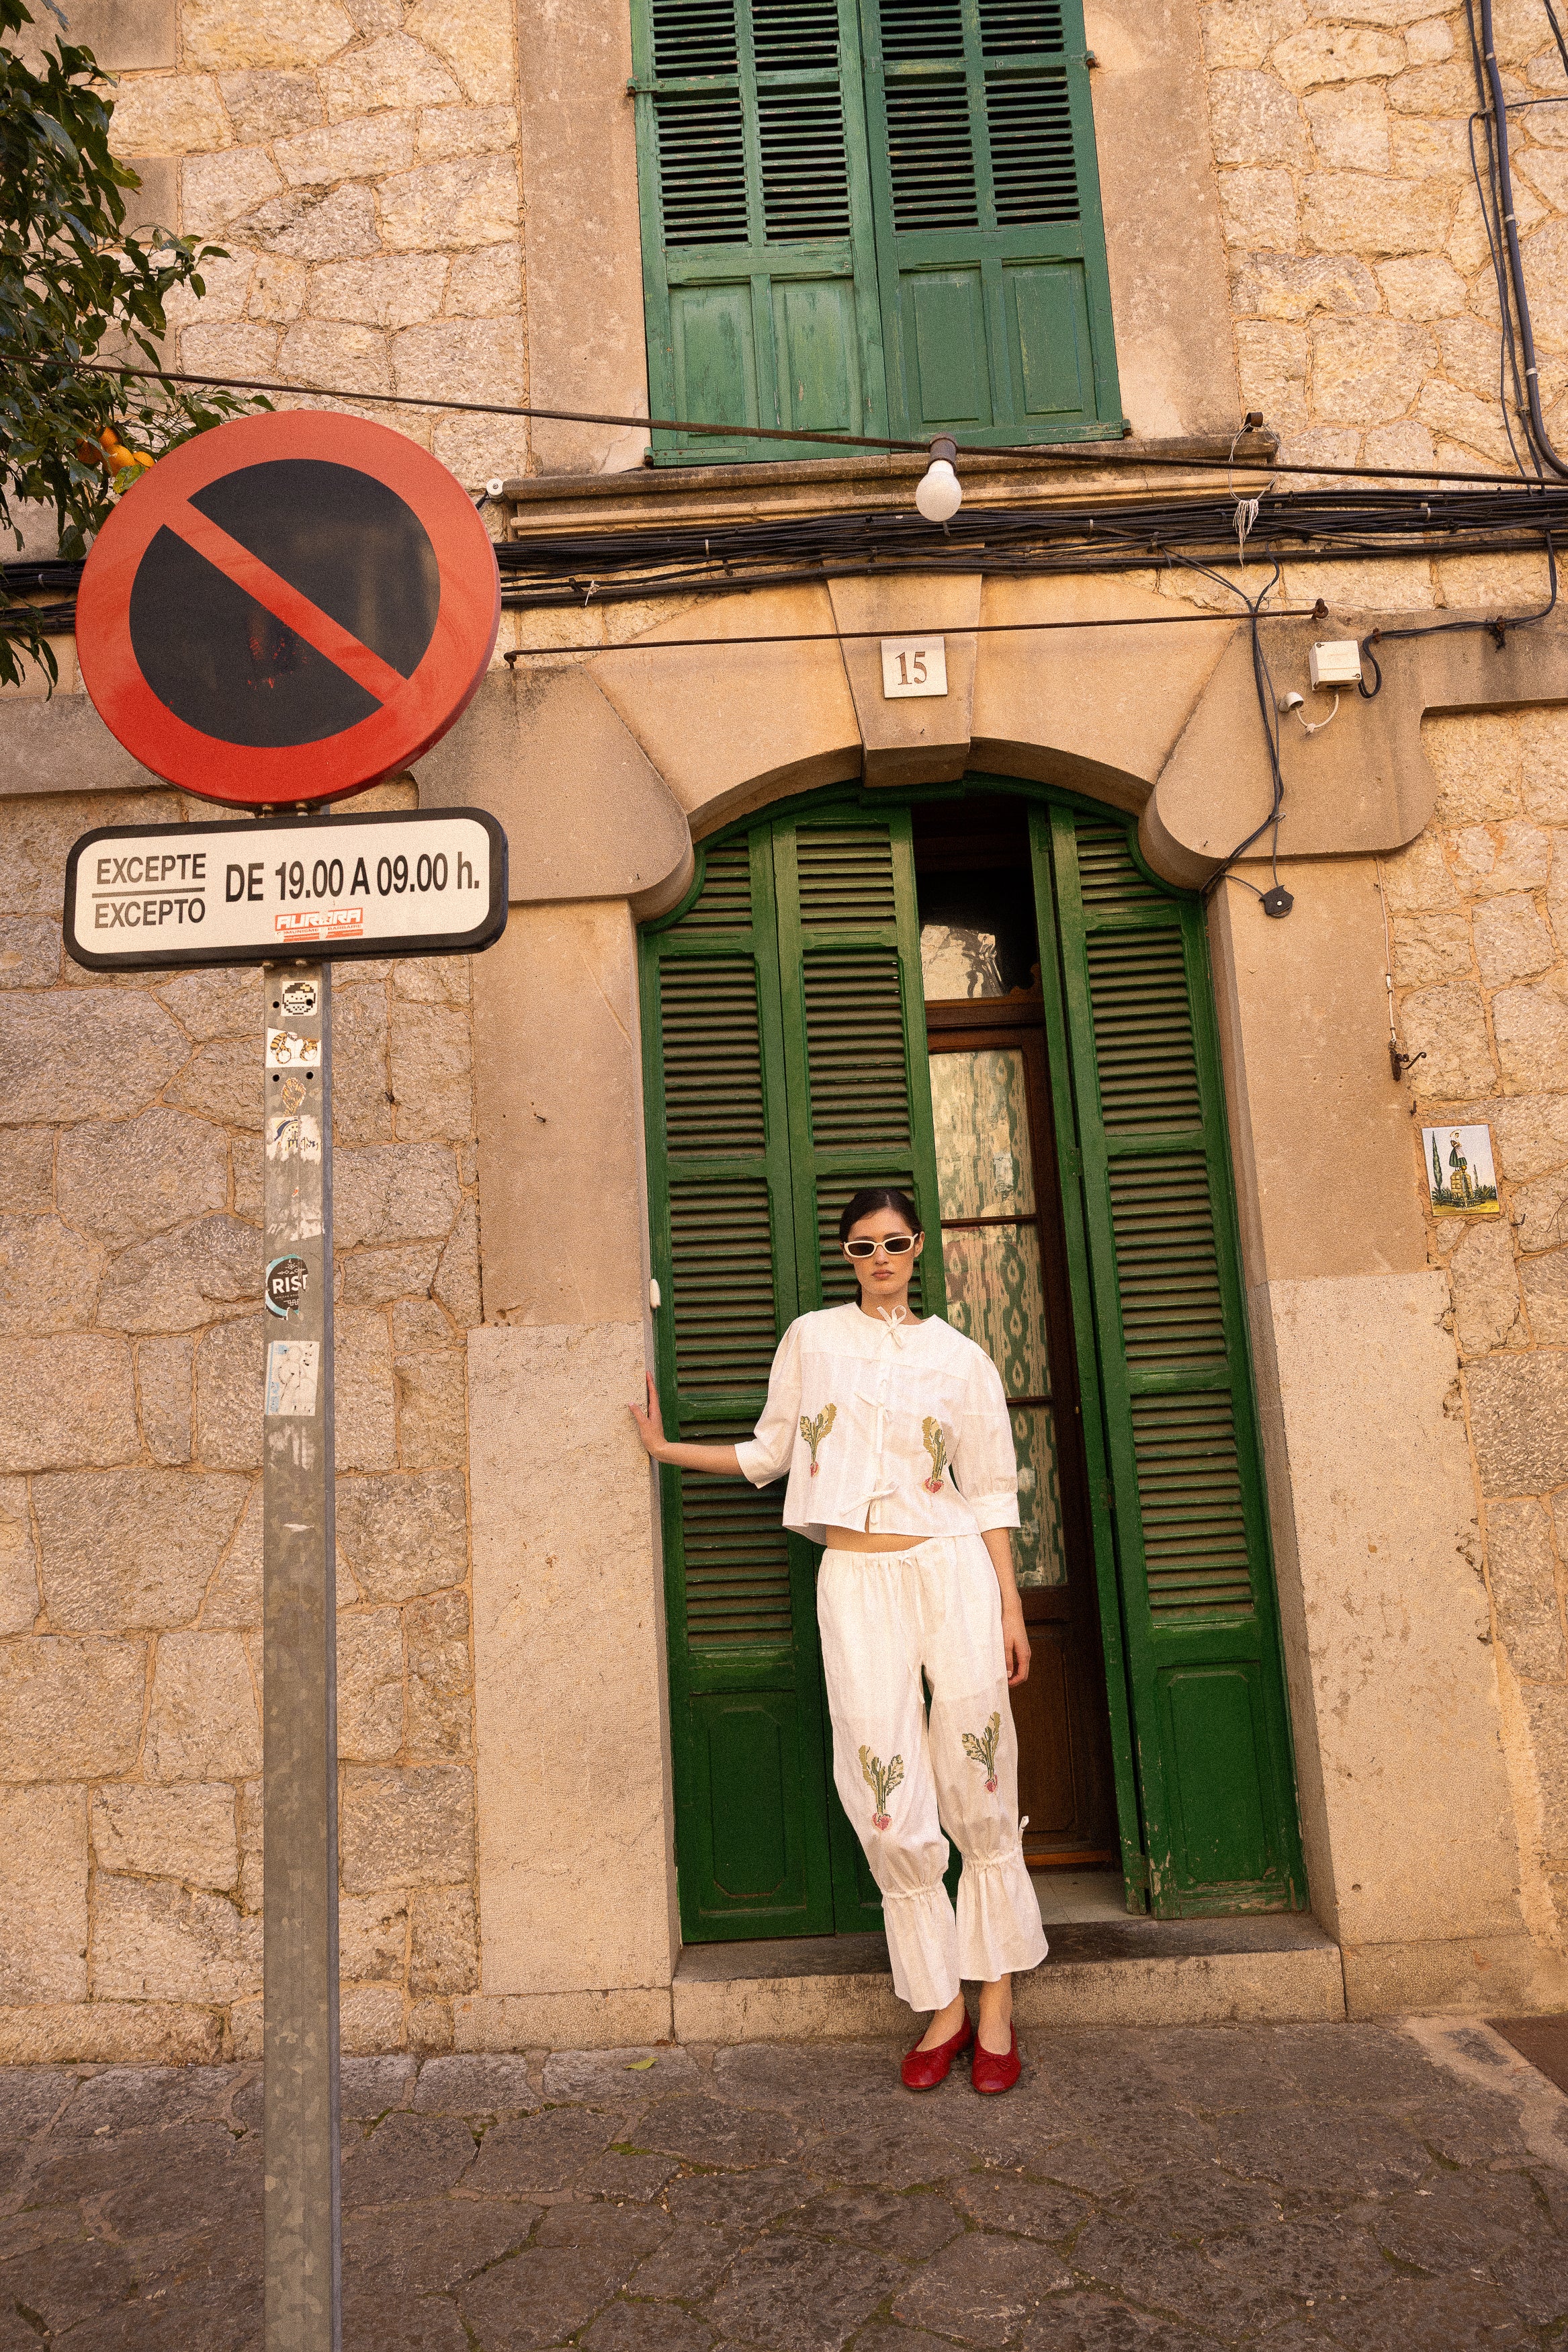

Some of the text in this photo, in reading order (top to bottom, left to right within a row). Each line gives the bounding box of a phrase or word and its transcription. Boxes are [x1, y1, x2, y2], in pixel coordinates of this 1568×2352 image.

[895, 651, 927, 685] 15
[97, 853, 206, 884] EXCEPTE
[226, 851, 480, 902] DE 19.00 A 09.00 h.
[95, 898, 206, 929] EXCEPTO
